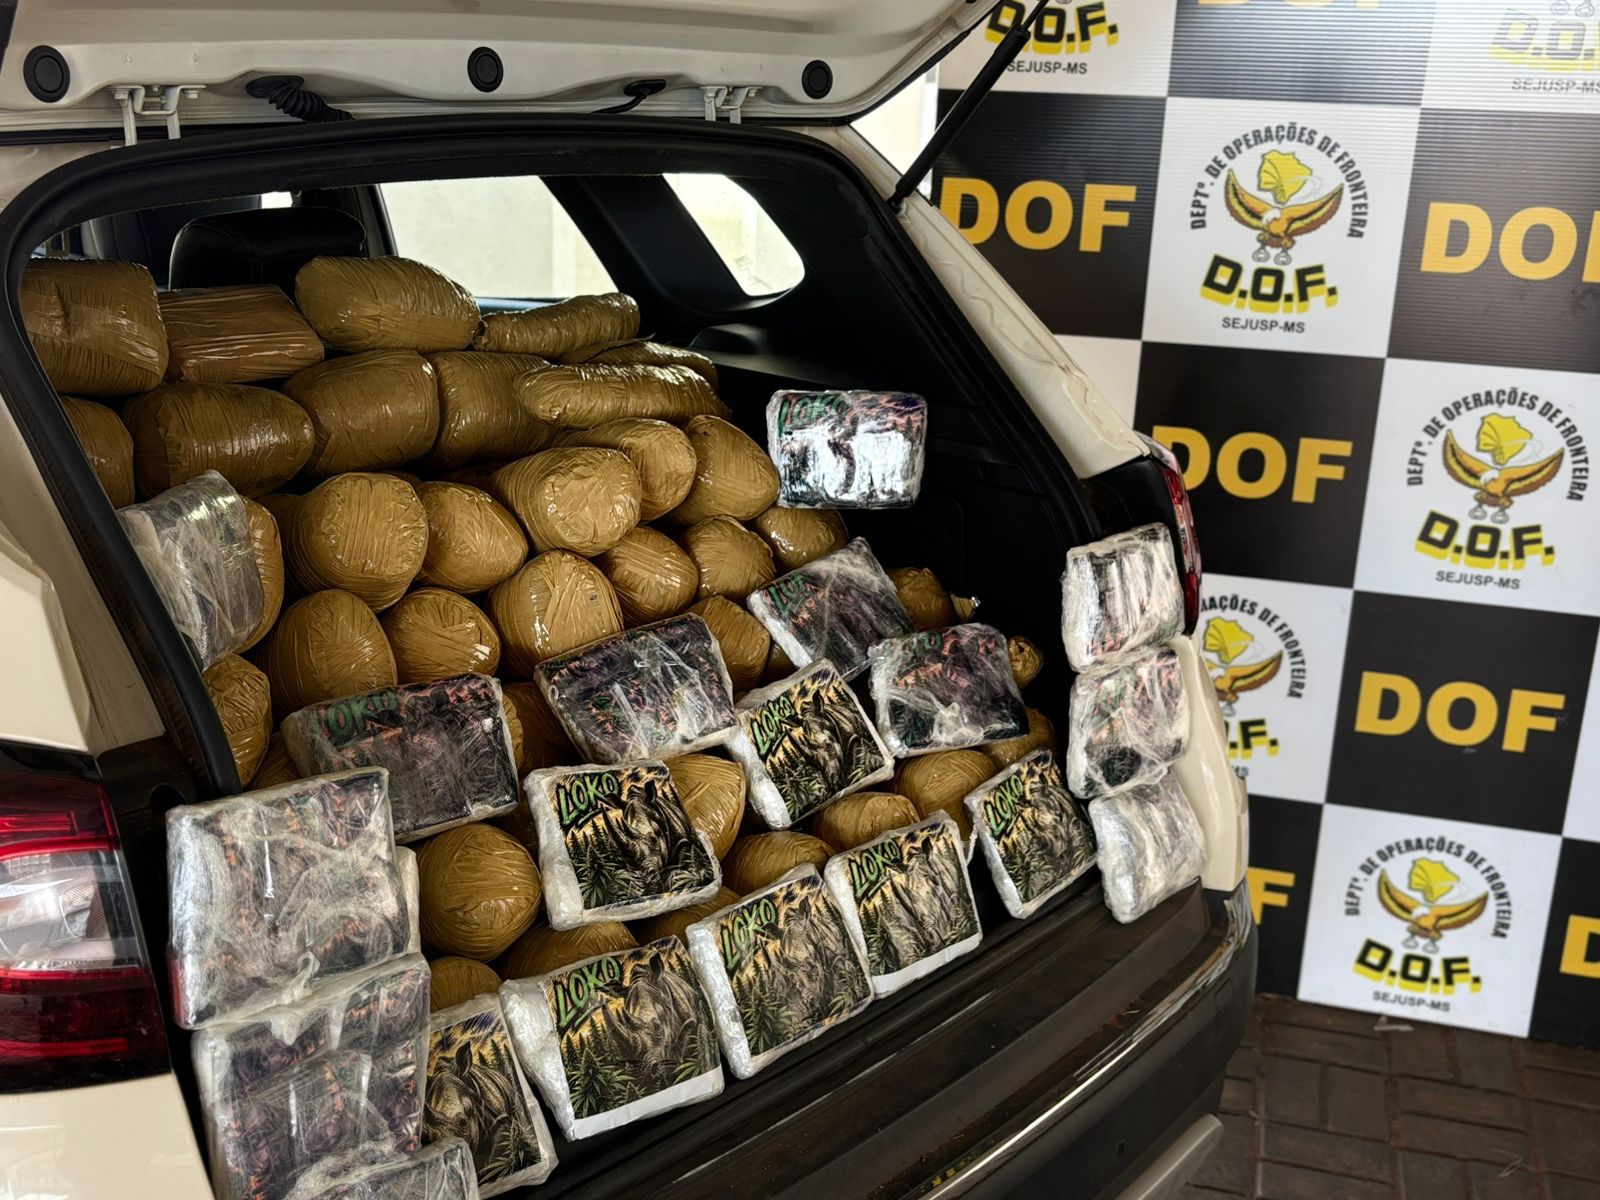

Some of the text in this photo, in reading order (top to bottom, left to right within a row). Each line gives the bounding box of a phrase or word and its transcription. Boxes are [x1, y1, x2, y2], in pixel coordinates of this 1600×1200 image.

[1007, 60, 1088, 75] SEJUSP-MS
[1204, 155, 1227, 180] DE
[1222, 122, 1318, 161] OPERAÇÕES
[1316, 135, 1341, 158] DE
[1333, 151, 1369, 239] FRONTEIRA
[939, 177, 1136, 252] DOF
[1200, 254, 1338, 313] D.O.F.
[1221, 316, 1306, 334] SEJUSP-MS
[1152, 425, 1353, 503] DOF
[1422, 416, 1446, 439] DE
[1441, 387, 1540, 422] OPERAÇÕES
[1538, 400, 1563, 424] DE
[1554, 417, 1590, 502] FRONTEIRA
[1415, 510, 1556, 570] D.O.F.
[1435, 570, 1521, 590] SEJUSP-MS
[1257, 607, 1280, 628] DE
[1273, 622, 1307, 699] FRONTEIRA
[1354, 671, 1565, 752] DOF
[558, 772, 620, 826] LOKO
[985, 774, 1025, 838] LOKO
[850, 838, 901, 897] LOKO
[1359, 857, 1380, 876] DE
[1376, 835, 1465, 863] OPERAÇÕES
[1464, 850, 1487, 869] DE
[1480, 864, 1512, 939] FRONTEIRA
[721, 899, 776, 970] LOKO
[1353, 938, 1482, 995] D.O.F.
[554, 957, 621, 1029] LOKO
[1372, 990, 1451, 1012] SEJUSP-MS
